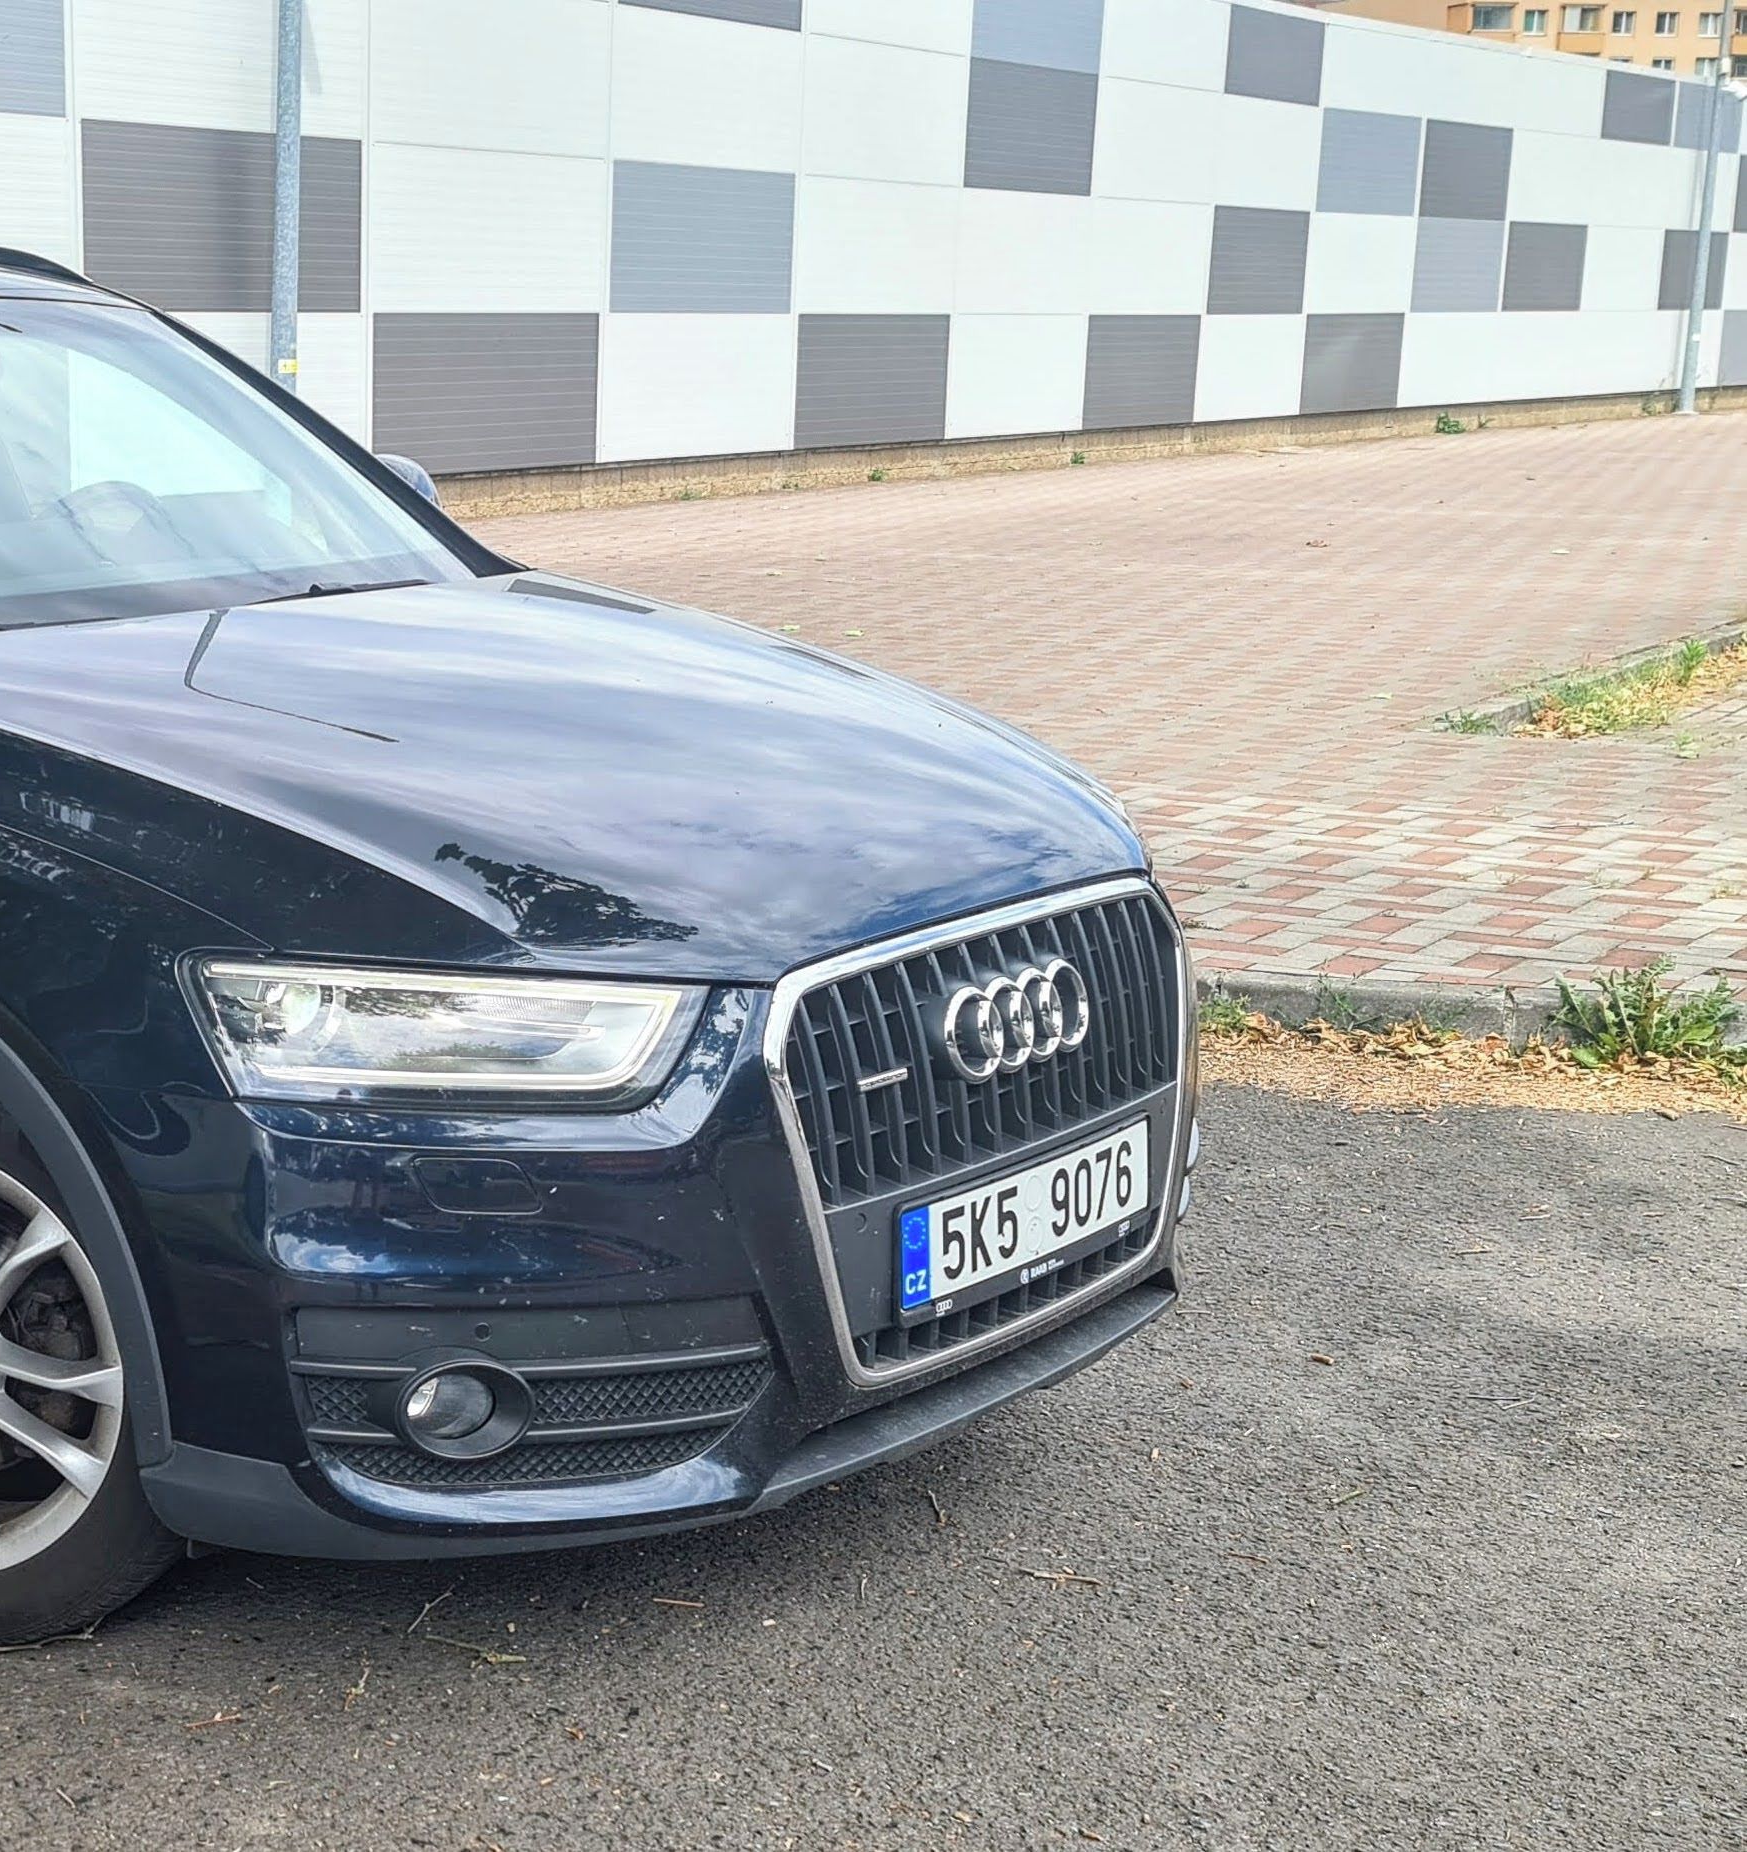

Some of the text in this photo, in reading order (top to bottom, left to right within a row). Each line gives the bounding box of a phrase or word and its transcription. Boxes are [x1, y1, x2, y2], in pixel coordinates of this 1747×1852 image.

[942, 1140, 1132, 1280] 5K5 9076
[905, 1269, 926, 1295] CZ
